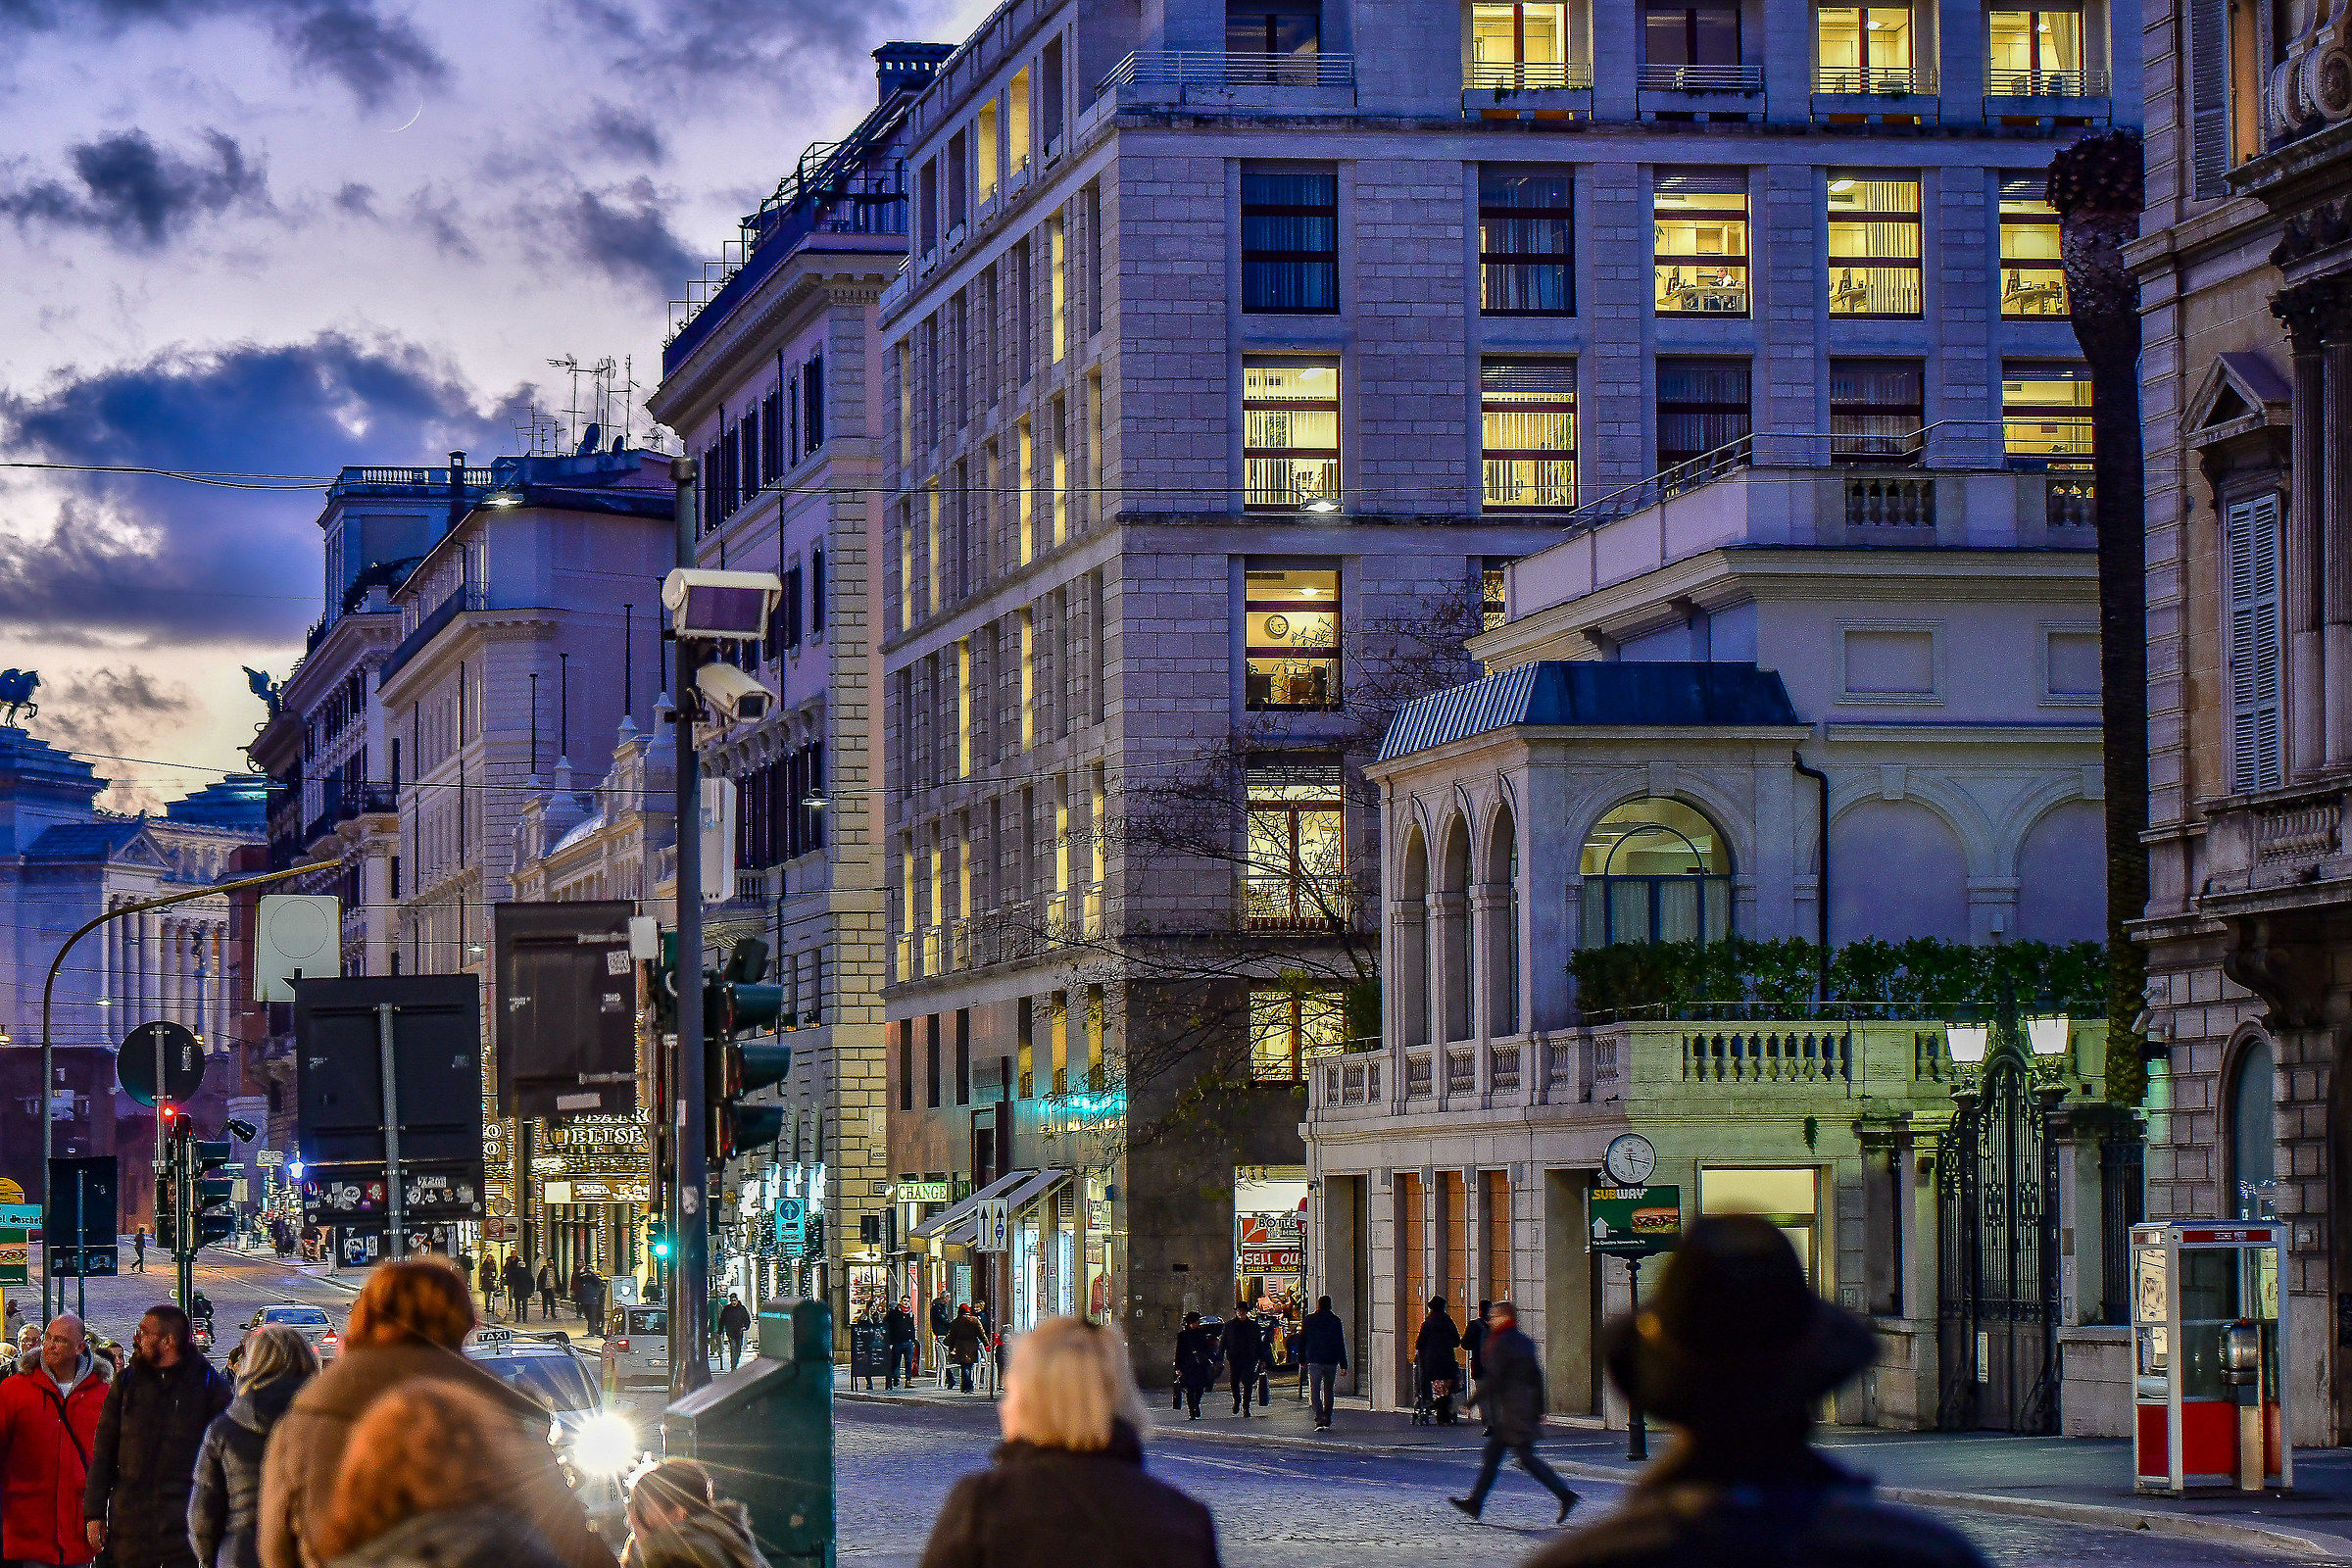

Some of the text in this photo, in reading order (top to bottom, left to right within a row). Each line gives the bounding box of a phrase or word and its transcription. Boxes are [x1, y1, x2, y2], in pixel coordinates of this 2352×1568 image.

[571, 1126, 645, 1145] ELISE
[898, 1185, 947, 1200] CHANGE
[1592, 1188, 1648, 1200] SUBWAY
[1258, 1218, 1297, 1228] BOTTE
[1245, 1252, 1299, 1265] SELL OU
[479, 1332, 508, 1341] TAXI
